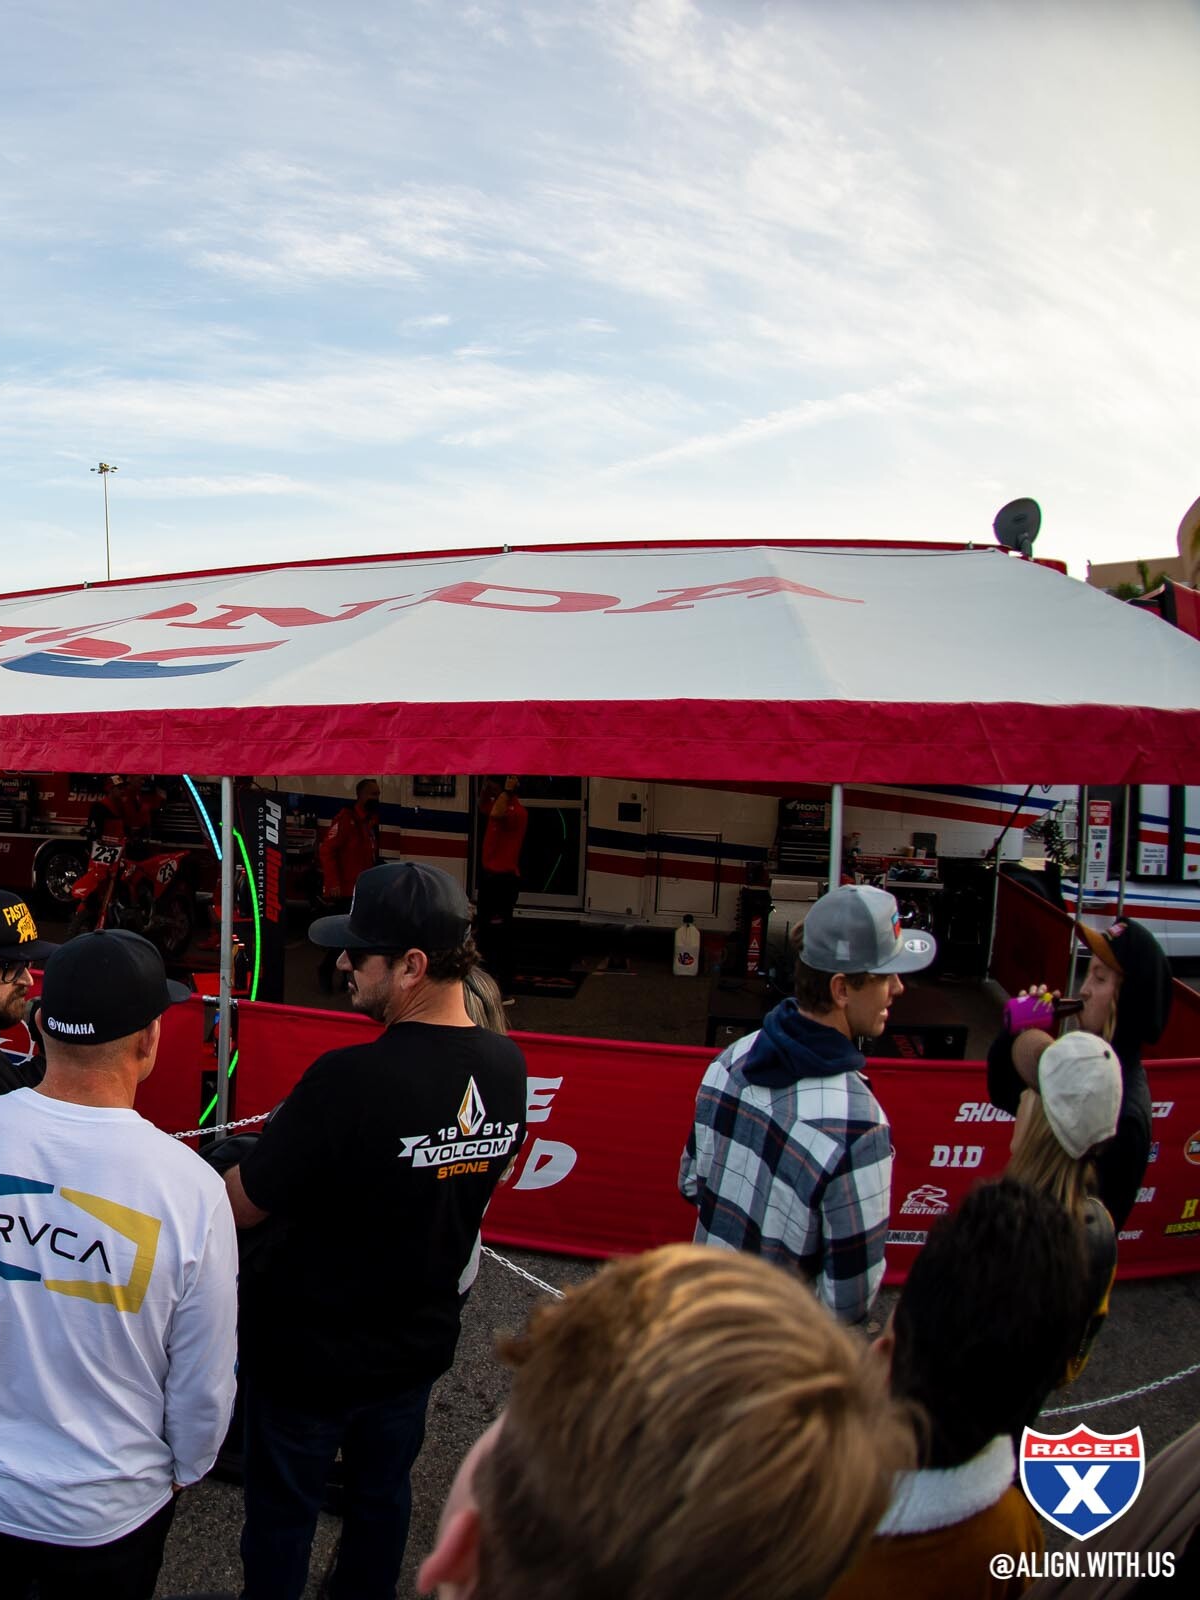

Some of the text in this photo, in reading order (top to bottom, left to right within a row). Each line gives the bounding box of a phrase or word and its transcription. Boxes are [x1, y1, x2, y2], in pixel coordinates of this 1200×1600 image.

[266, 799, 282, 845] Pro
[94, 847, 118, 864] 23
[56, 1020, 95, 1035] YAMAHA
[437, 1121, 502, 1142] 19 91
[423, 1139, 508, 1164] VOLCOM
[437, 1161, 490, 1179] STONE
